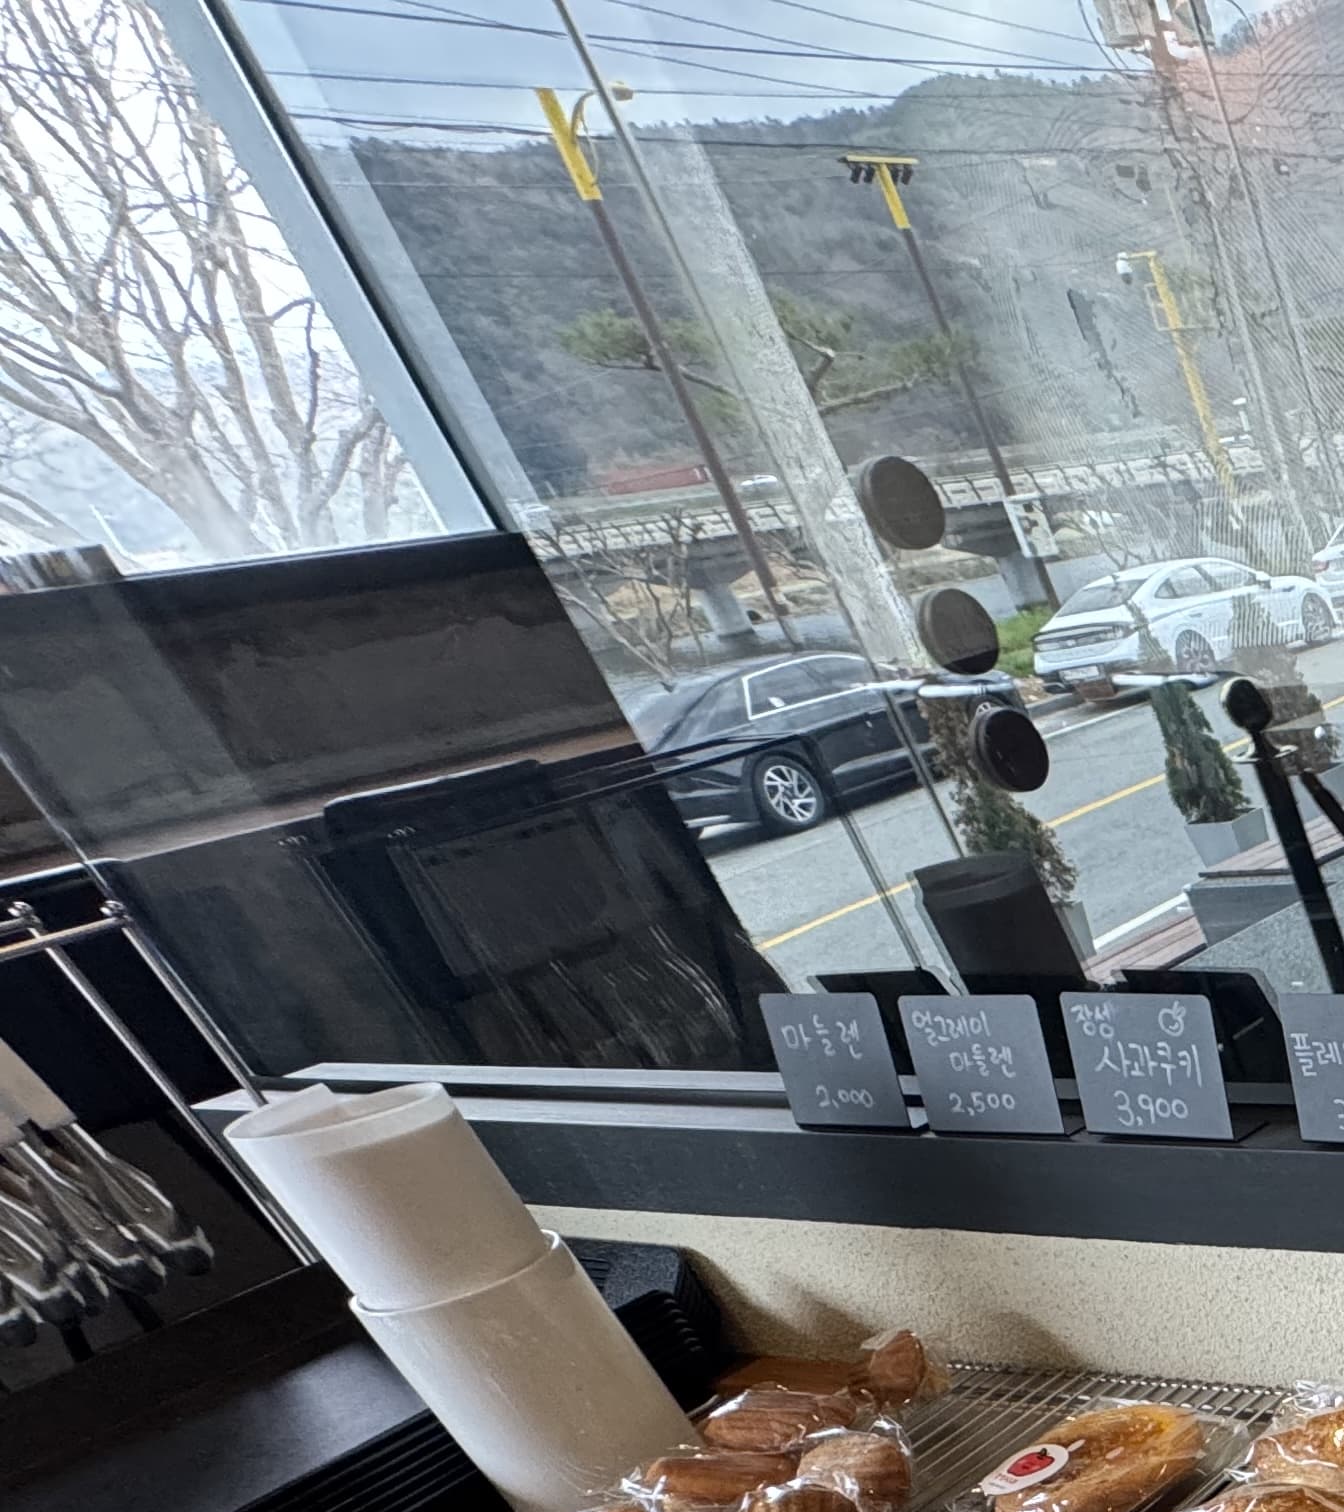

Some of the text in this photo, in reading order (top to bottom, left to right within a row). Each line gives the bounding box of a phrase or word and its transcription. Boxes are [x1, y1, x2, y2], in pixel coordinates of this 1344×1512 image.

[911, 1010, 991, 1048] 얼그레이
[949, 1042, 1017, 1078] 마들렌
[1095, 1040, 1203, 1088] 사과쿠키
[815, 1084, 874, 1109] 2,000
[949, 1091, 1016, 1117] 2,500
[1113, 1090, 1189, 1127] 3,900
